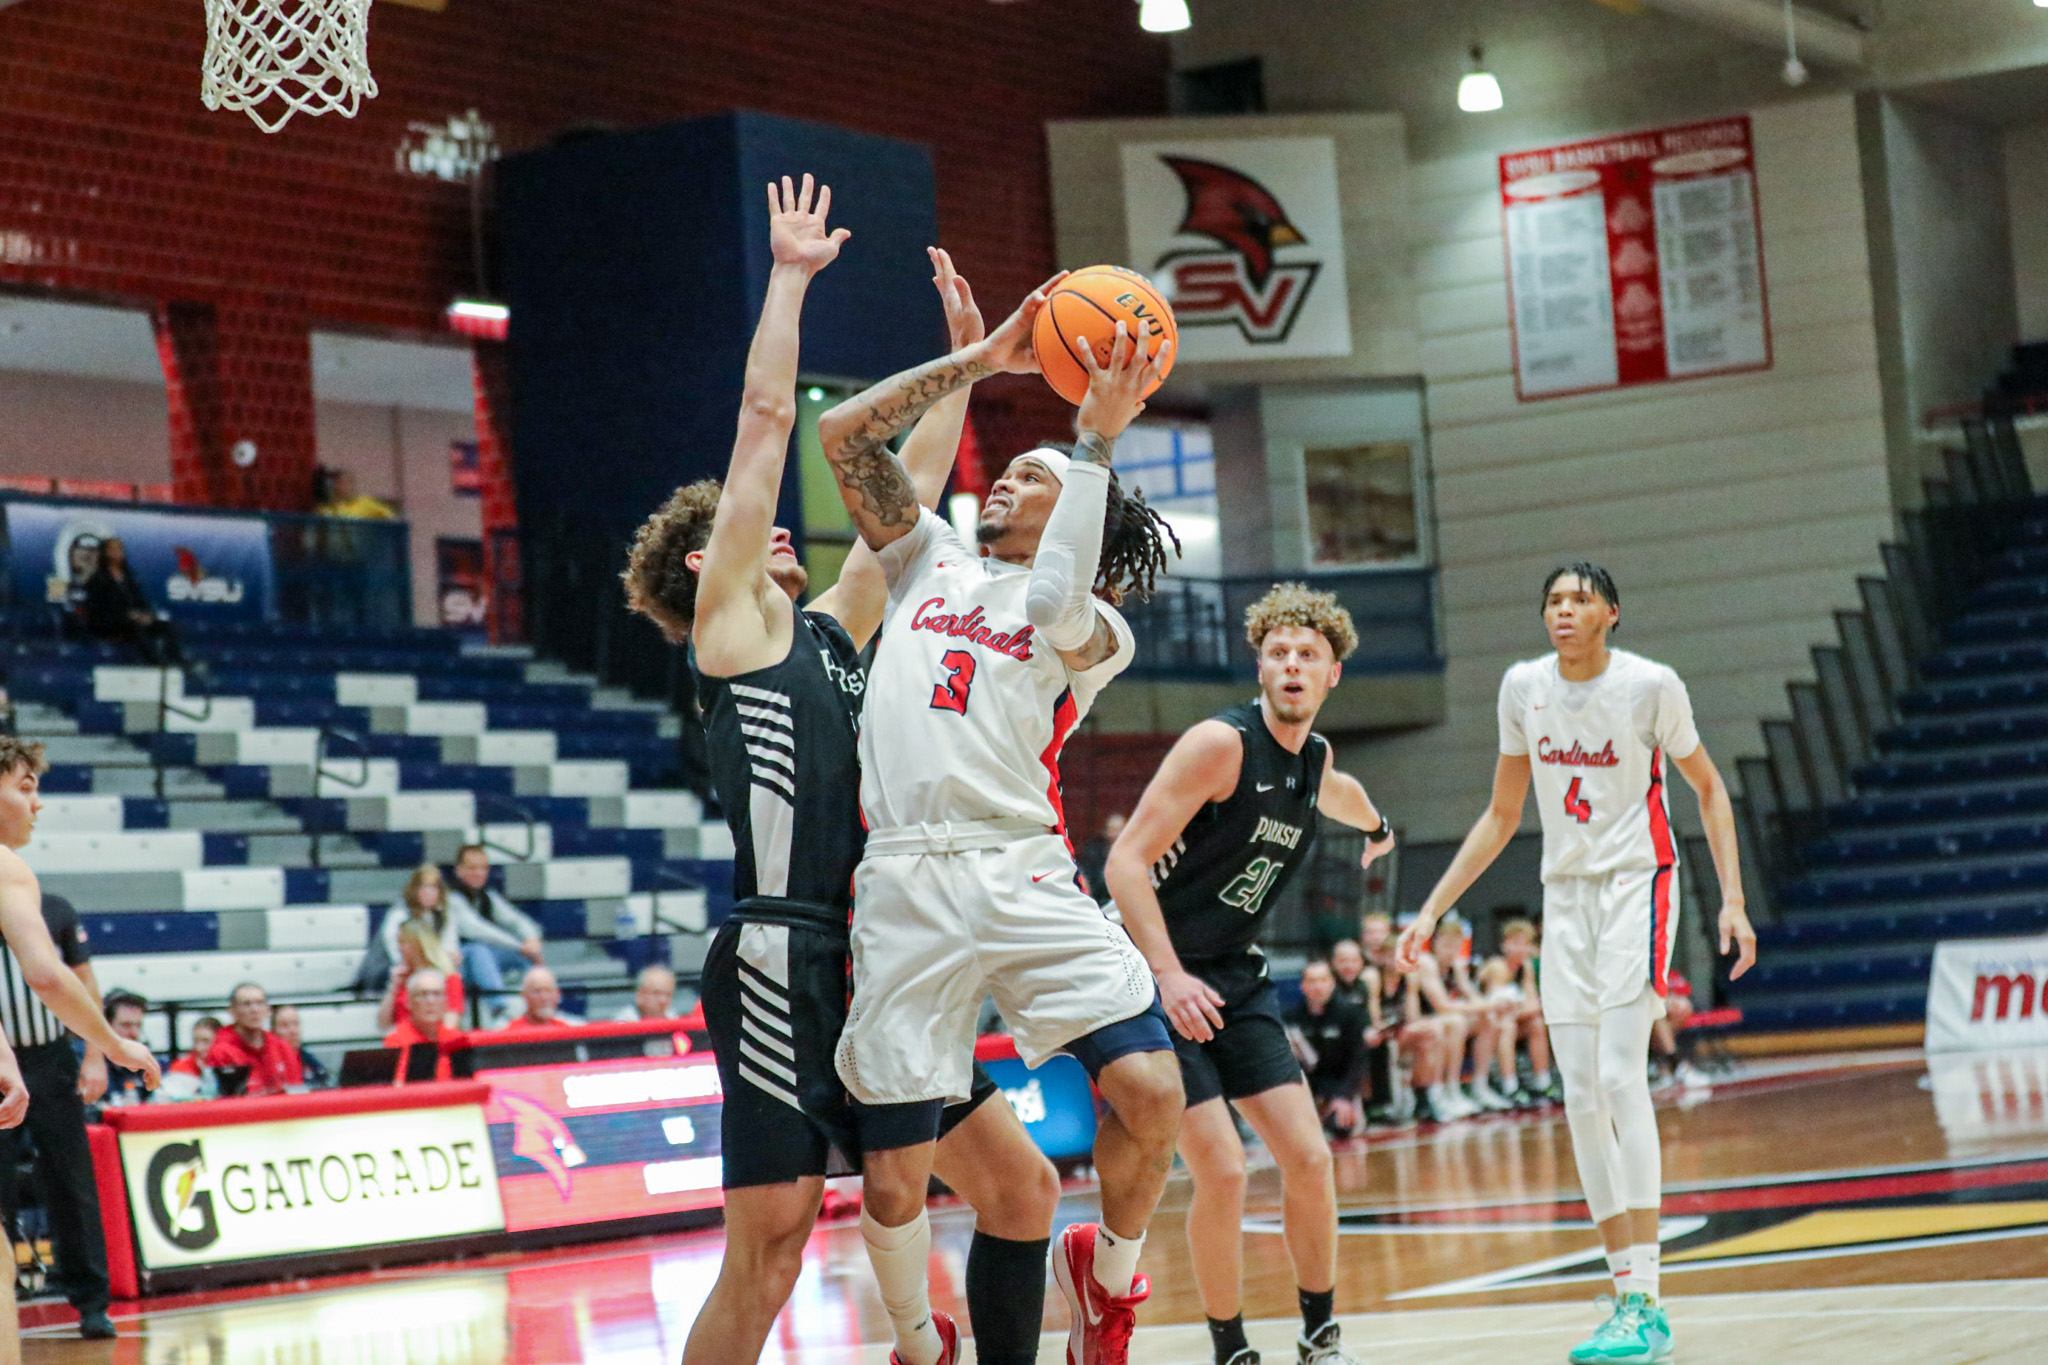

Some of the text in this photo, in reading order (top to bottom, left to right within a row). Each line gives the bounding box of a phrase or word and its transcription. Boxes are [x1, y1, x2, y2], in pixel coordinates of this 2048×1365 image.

[911, 597, 1035, 662] Cardinals
[929, 648, 977, 717] 3
[1538, 736, 1620, 767] Cardinals
[1564, 776, 1592, 824] 4
[222, 1142, 482, 1215] GATORADE
